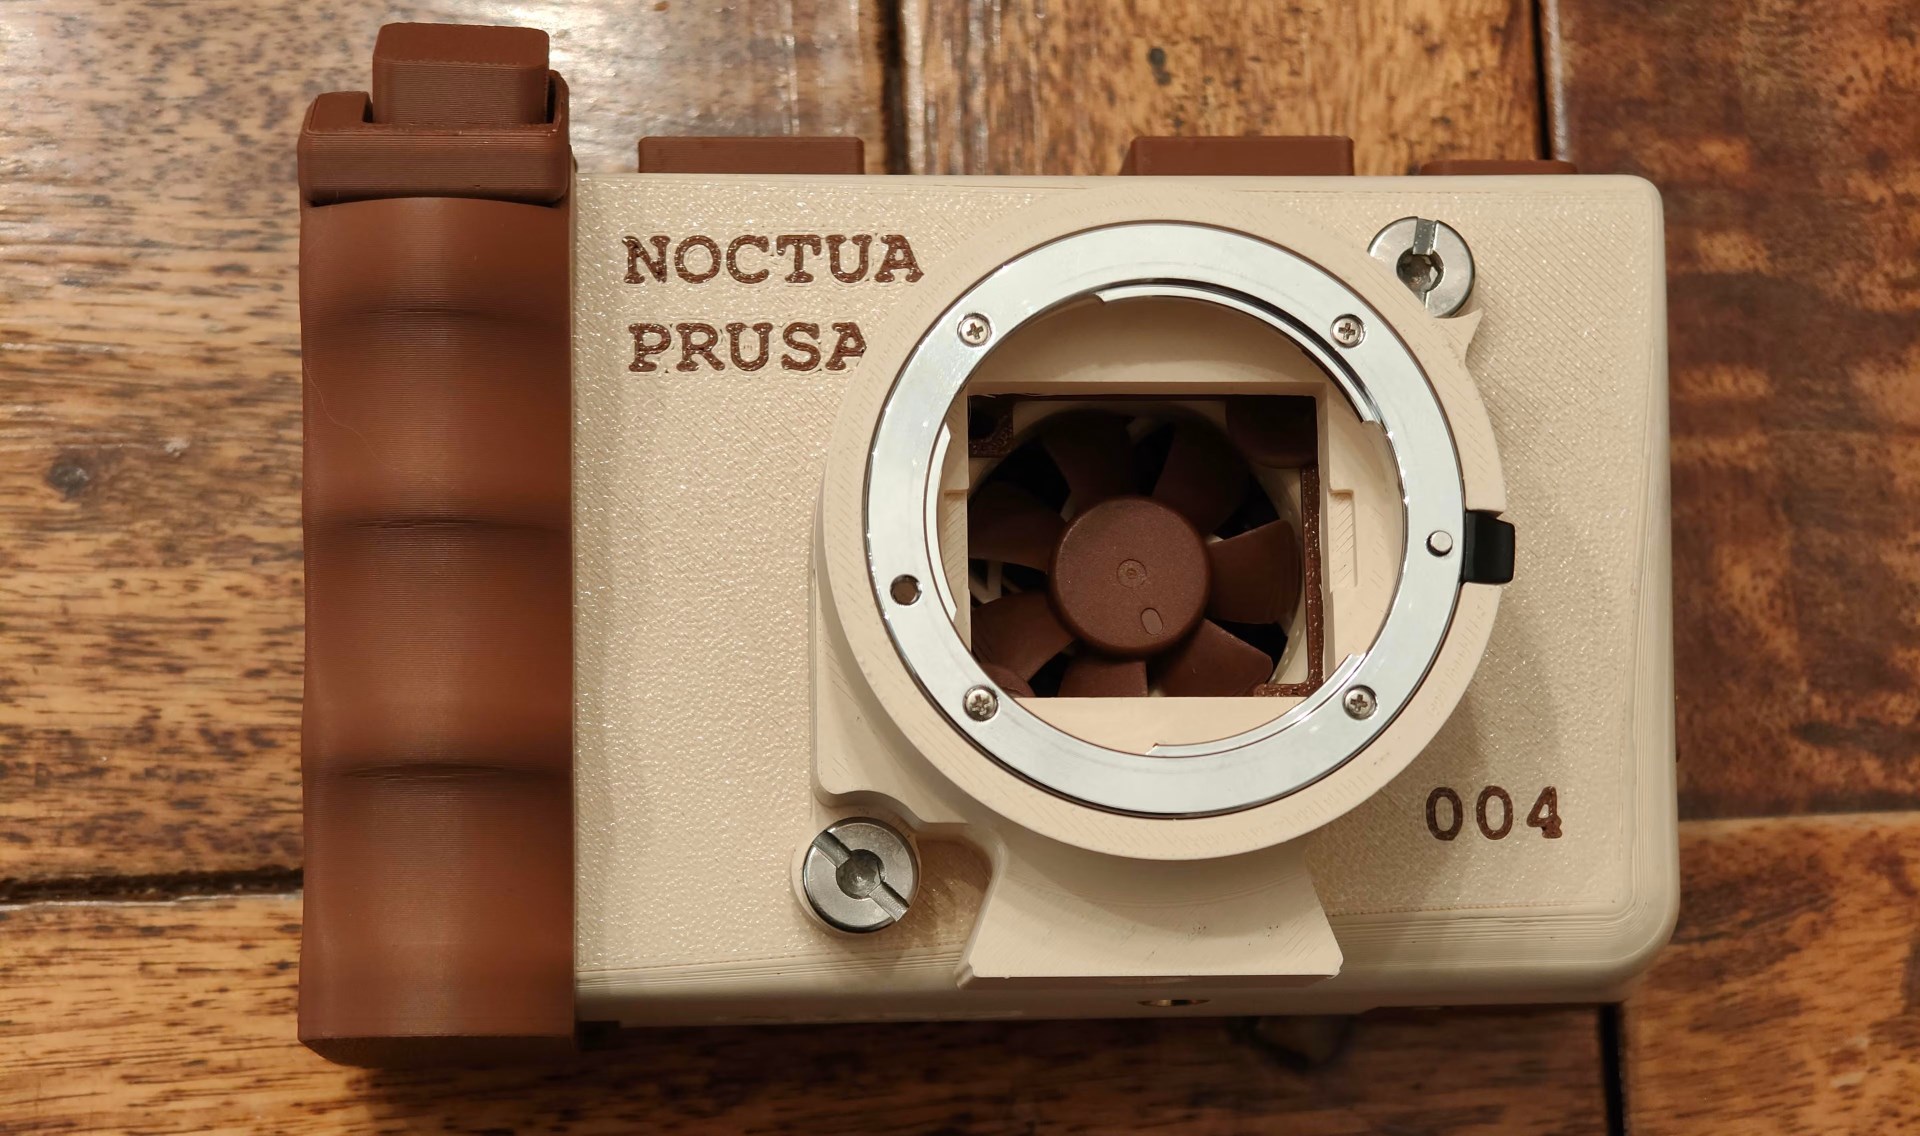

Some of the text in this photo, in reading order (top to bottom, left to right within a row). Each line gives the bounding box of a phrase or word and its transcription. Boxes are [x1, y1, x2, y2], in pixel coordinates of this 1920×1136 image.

[622, 234, 925, 285] NOCTUA
[628, 321, 868, 373] PRUSA
[1425, 785, 1563, 841] 004
